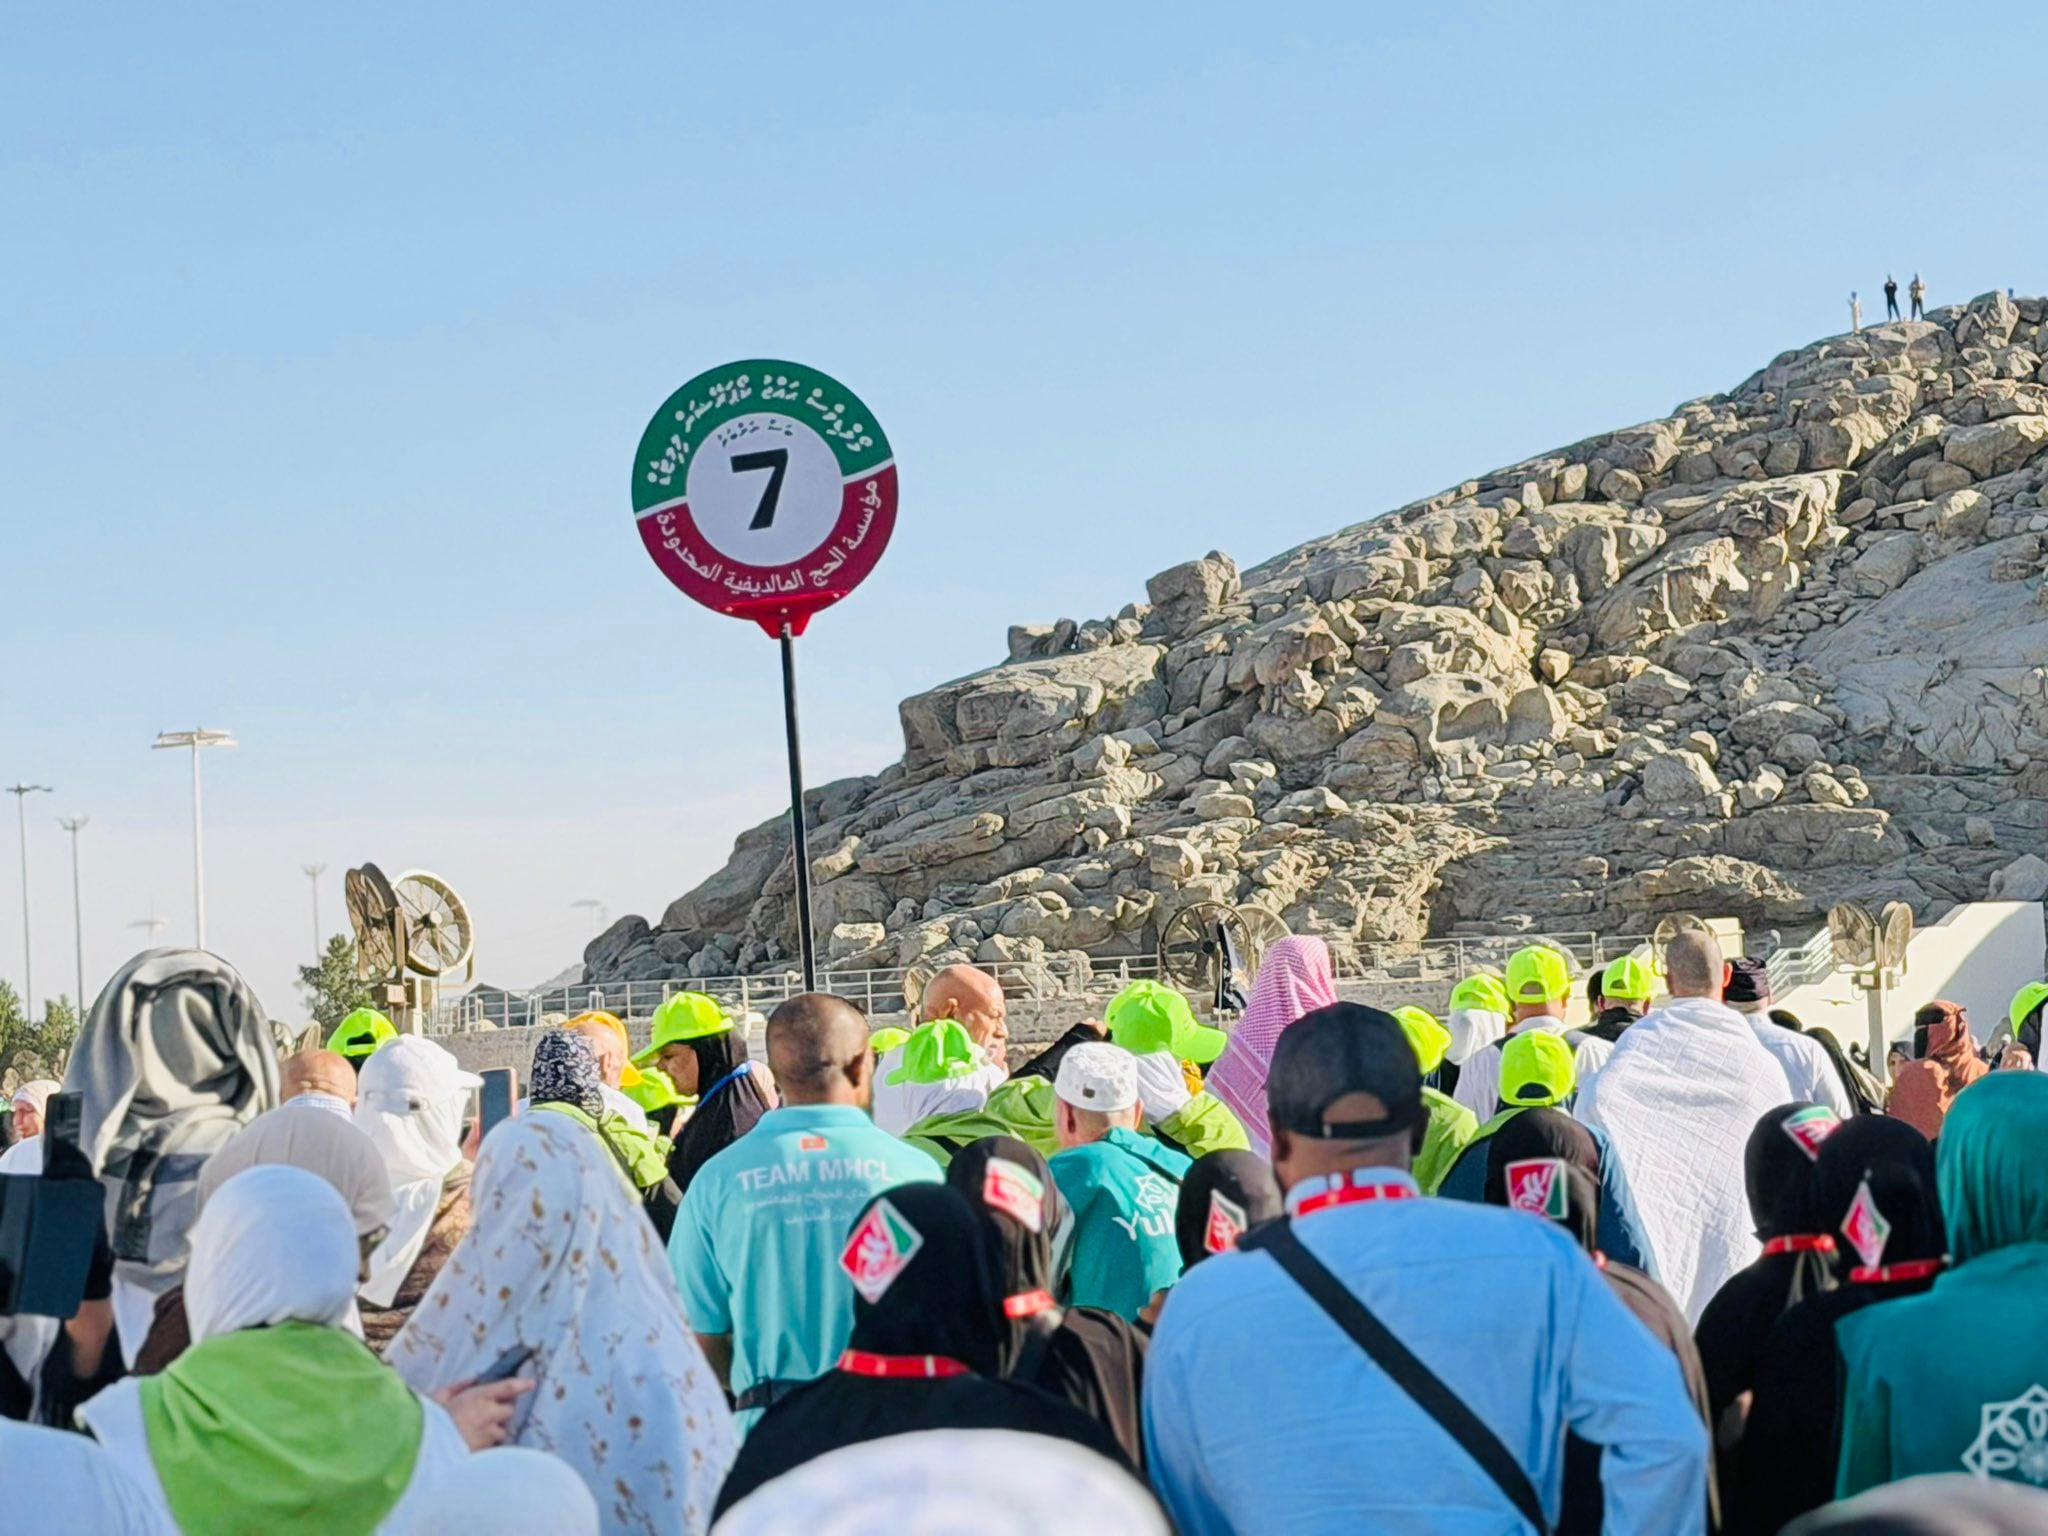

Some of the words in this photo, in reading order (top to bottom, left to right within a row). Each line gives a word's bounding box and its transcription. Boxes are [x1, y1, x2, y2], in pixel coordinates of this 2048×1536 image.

[730, 448, 788, 530] 7
[843, 480, 881, 549] مؤسسة
[657, 513, 722, 580] المحدودة
[810, 547, 847, 586] الحج
[724, 569, 804, 597] المالديفية
[736, 1160, 810, 1191] TEAM
[819, 1157, 895, 1182] MHCL
